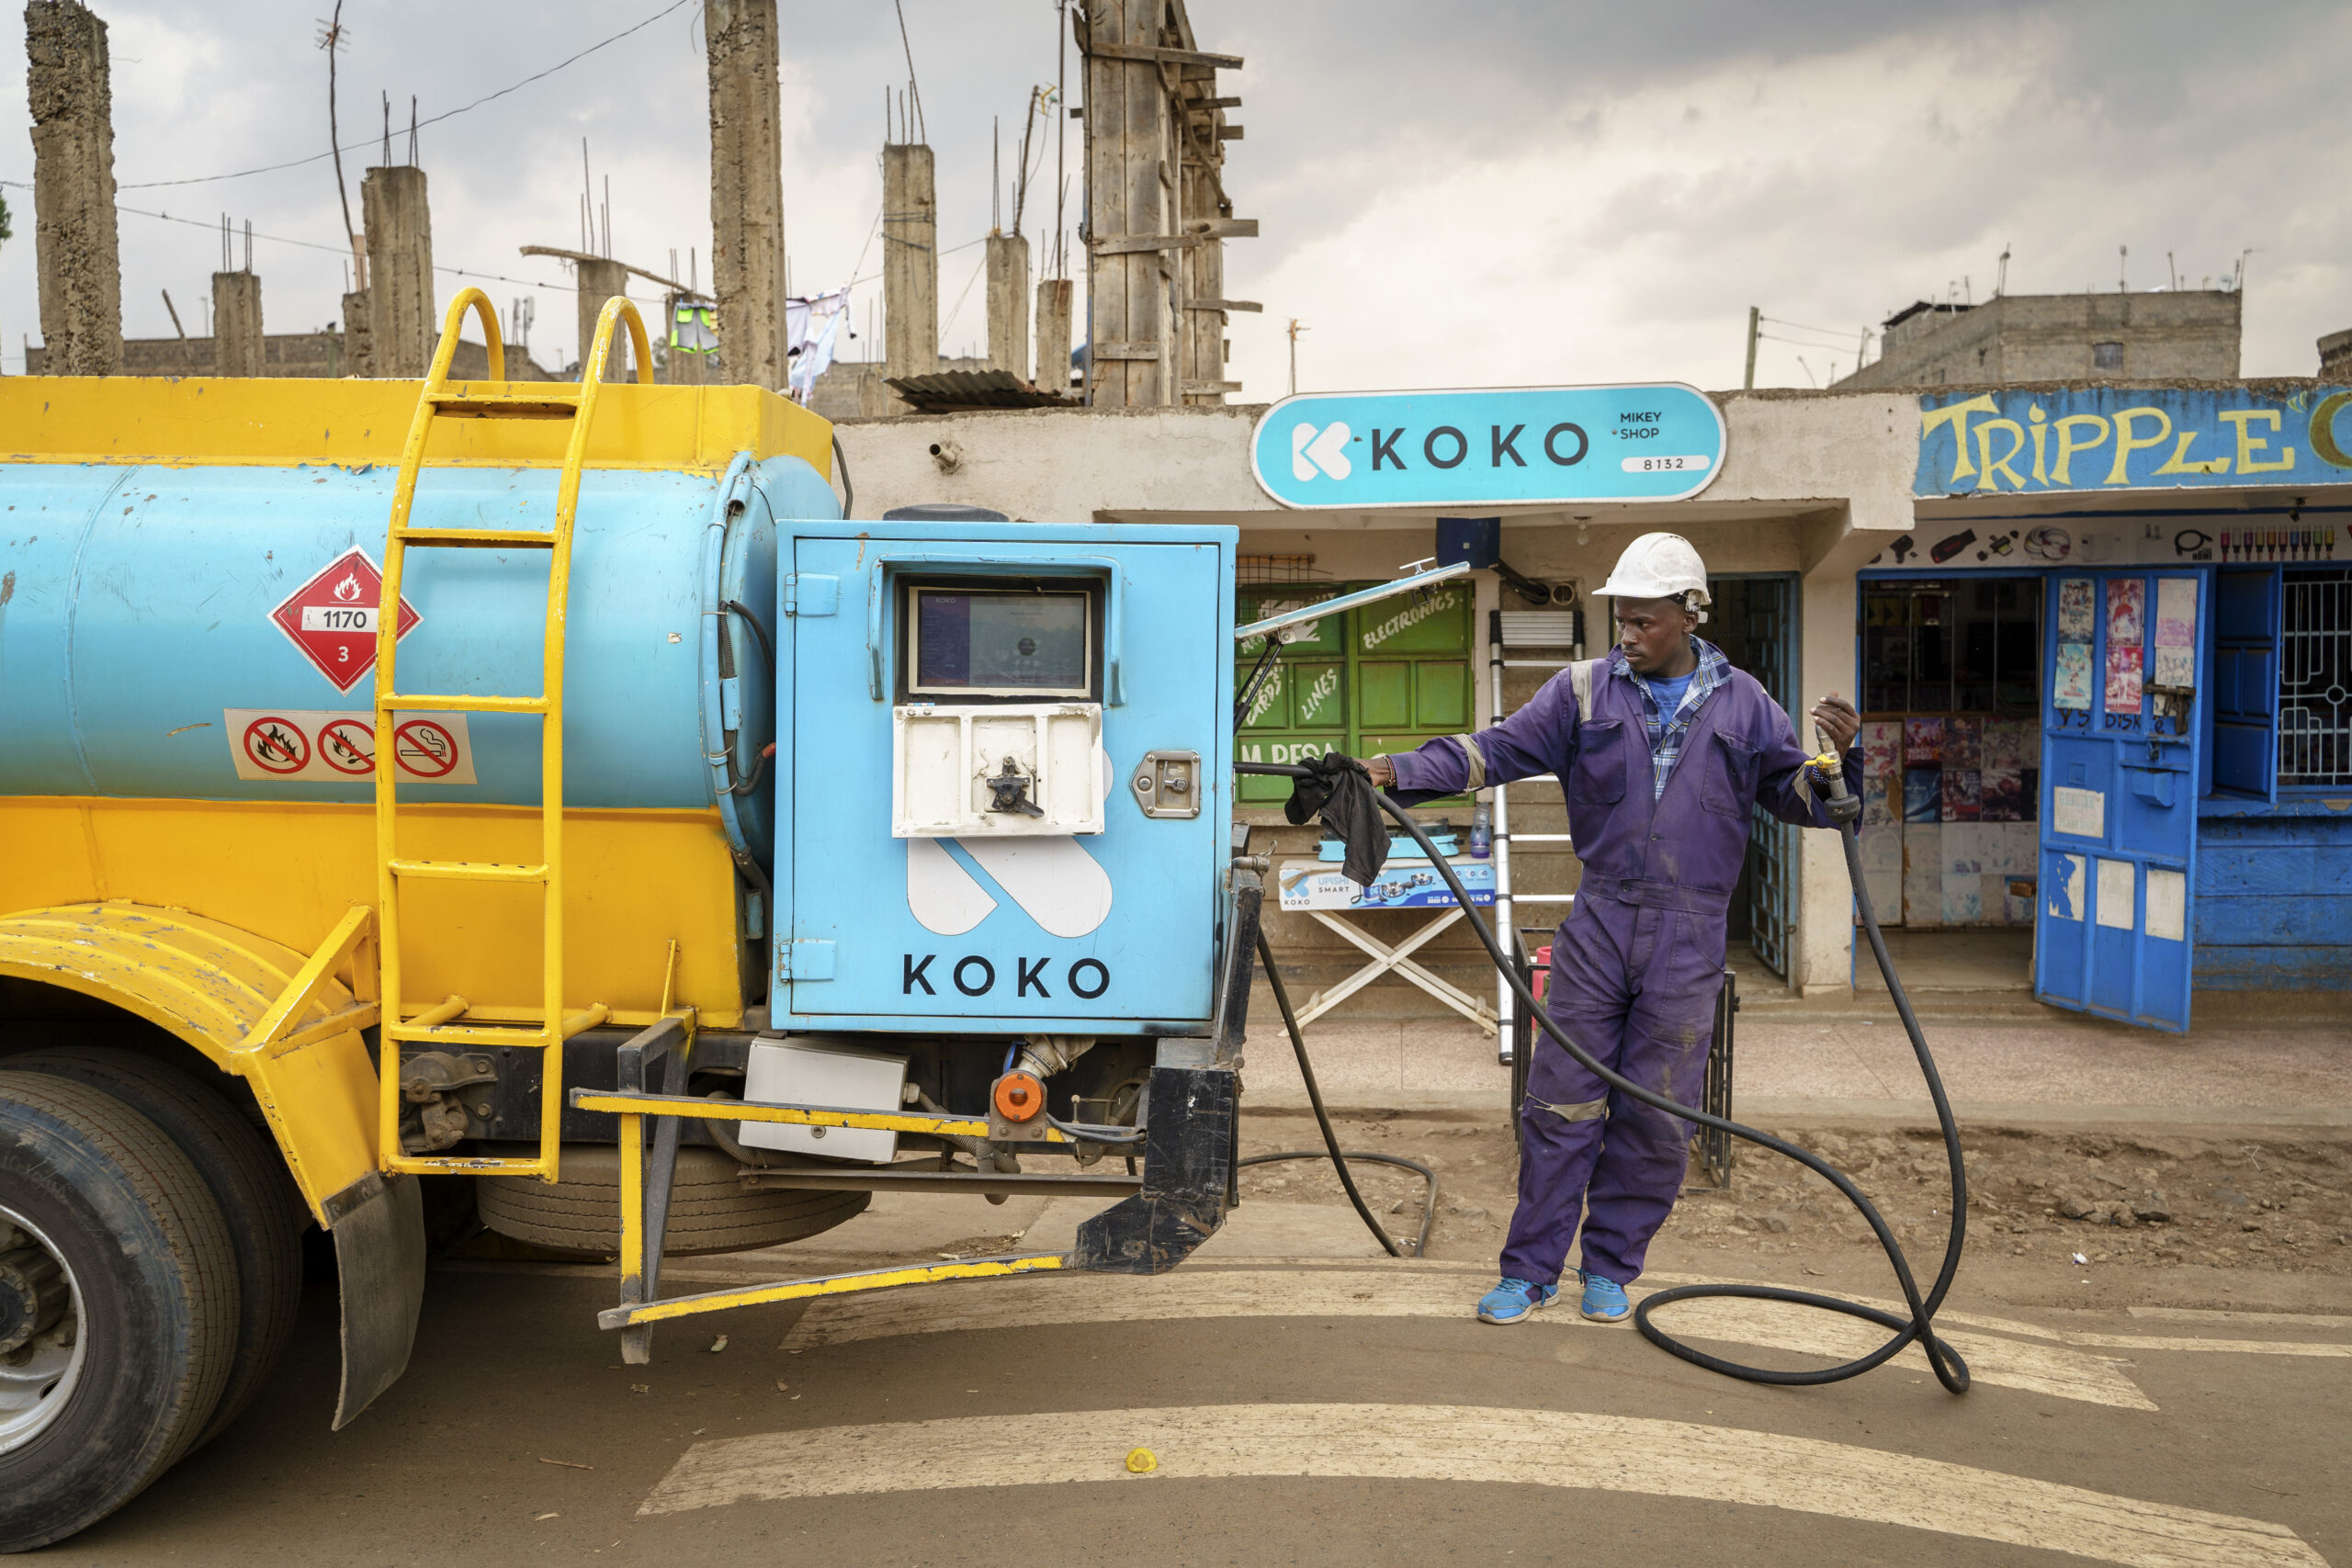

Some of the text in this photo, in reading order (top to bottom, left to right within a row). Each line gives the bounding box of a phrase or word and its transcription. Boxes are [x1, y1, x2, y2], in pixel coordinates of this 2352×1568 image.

[1621, 412, 1662, 423] MIKEY
[1621, 427, 1659, 440] SHOP
[1372, 423, 1589, 470] KOKO
[1644, 458, 1683, 470] 8132
[322, 610, 368, 629] 1170
[1363, 592, 1455, 649] ELECTRONICS
[337, 646, 349, 662] 3
[1301, 668, 1337, 720] LINES
[1317, 876, 1350, 886] UPISHI
[903, 954, 1110, 999] KOKO
